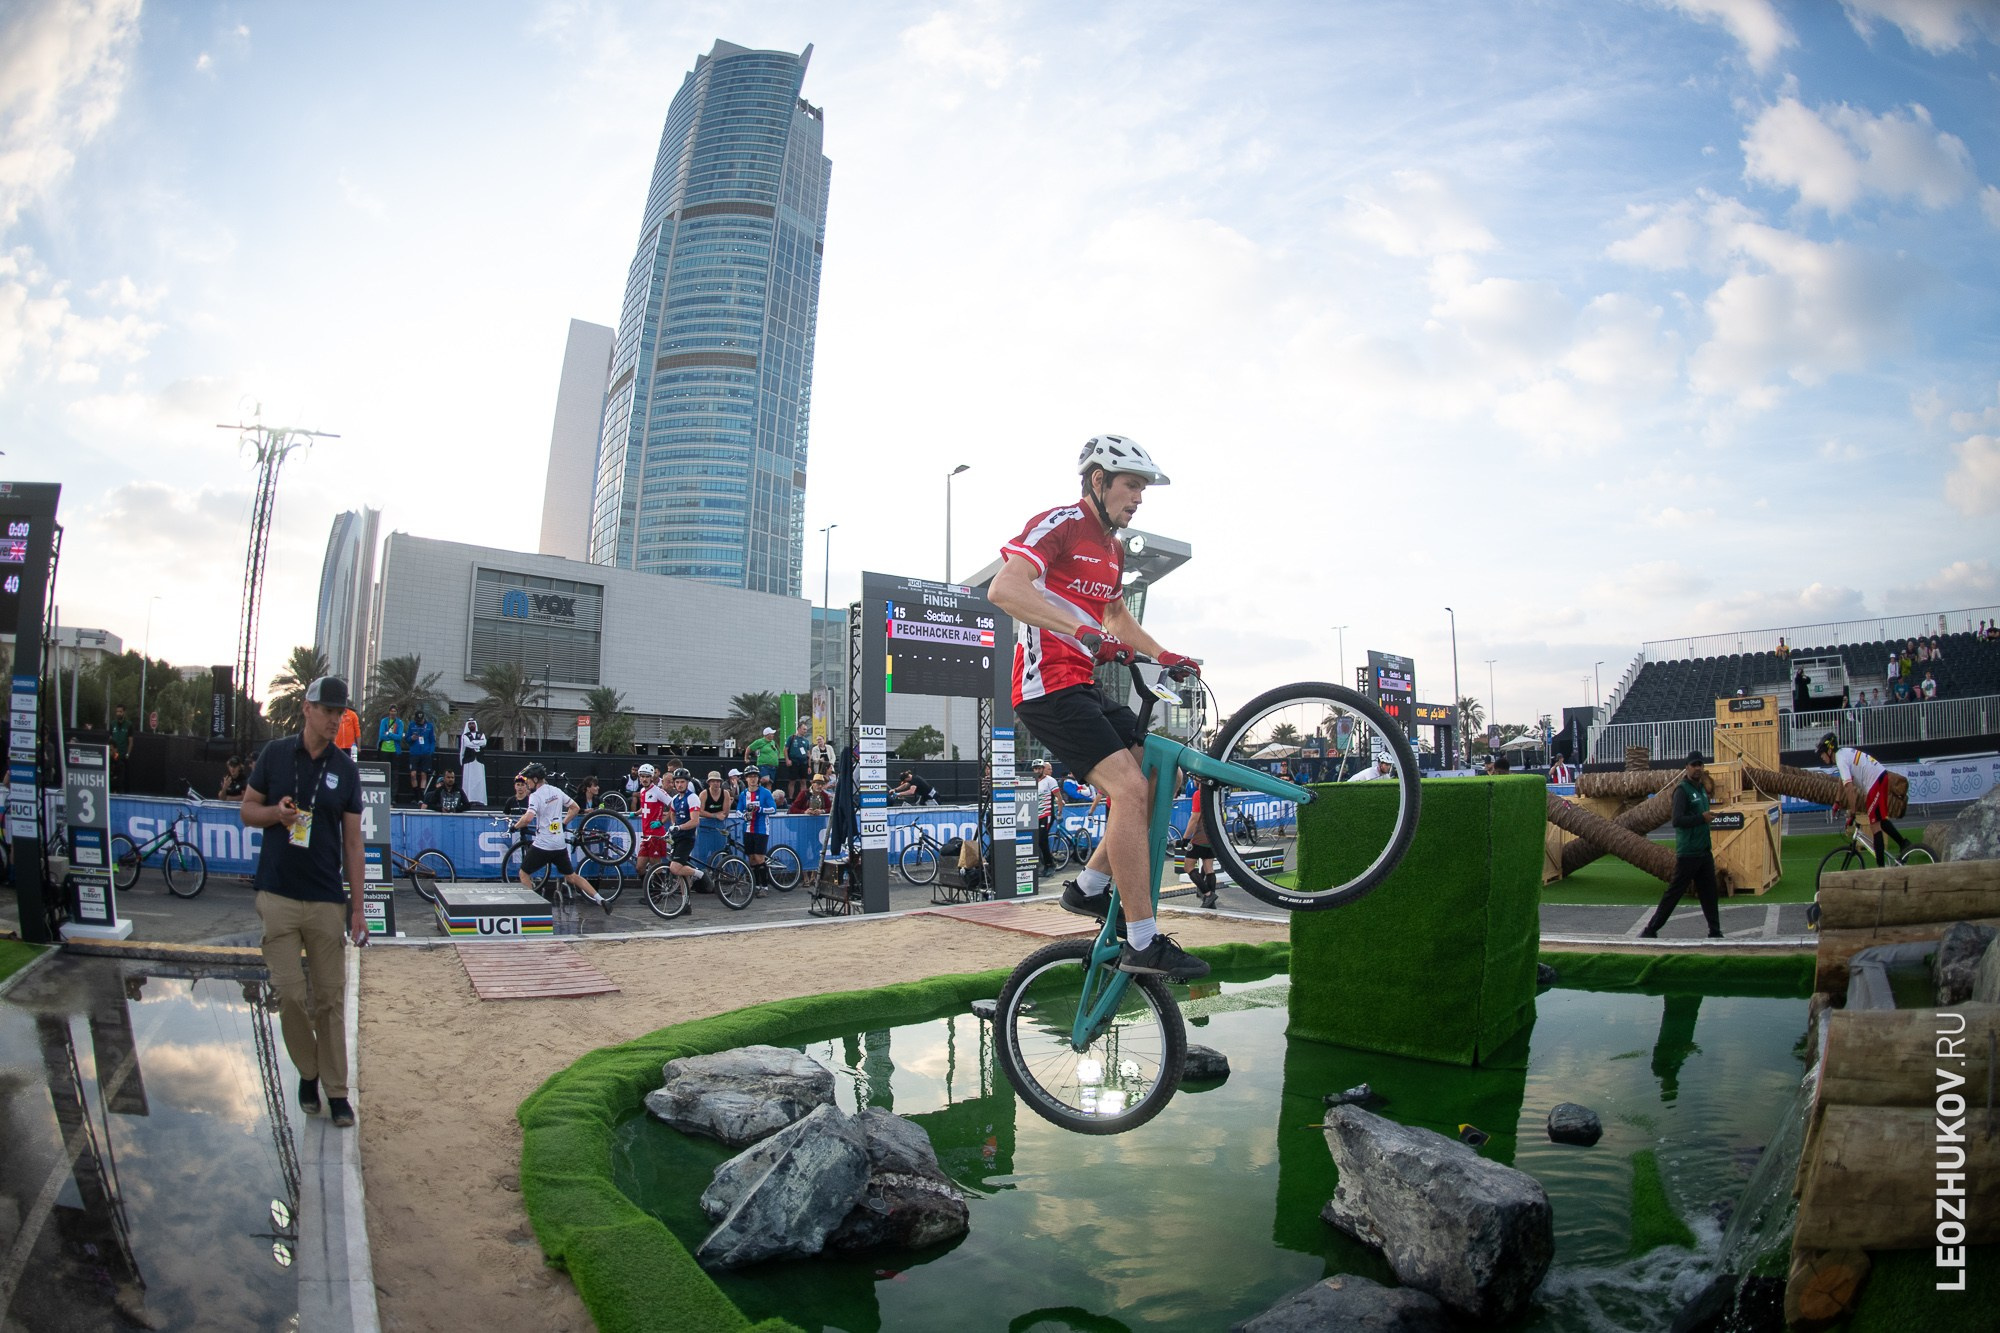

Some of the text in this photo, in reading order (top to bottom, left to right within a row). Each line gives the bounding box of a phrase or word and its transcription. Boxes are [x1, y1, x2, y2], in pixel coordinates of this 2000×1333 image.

[8, 523, 29, 536] 0:00
[4, 576, 19, 592] 40
[1066, 578, 1113, 599] AUSTR
[532, 593, 576, 617] VOX
[923, 594, 958, 608] FINISH
[894, 607, 906, 619] 15
[976, 617, 994, 629] 1:56
[897, 623, 981, 643] PECHHACKER Alex
[982, 656, 990, 669] 0
[1416, 707, 1428, 717] OME
[867, 727, 884, 736] UCI
[67, 772, 105, 787] FINISH
[1951, 773, 1983, 795] 360
[361, 790, 386, 803] ART
[16, 804, 32, 816] UCI
[78, 789, 95, 823] 3
[361, 806, 378, 839] 4
[1000, 817, 1014, 825] UCI
[1017, 803, 1031, 828] 4
[1722, 815, 1740, 823] dhabi
[868, 824, 885, 833] UCI
[1255, 858, 1272, 869] UCI
[478, 917, 518, 935] UCI
